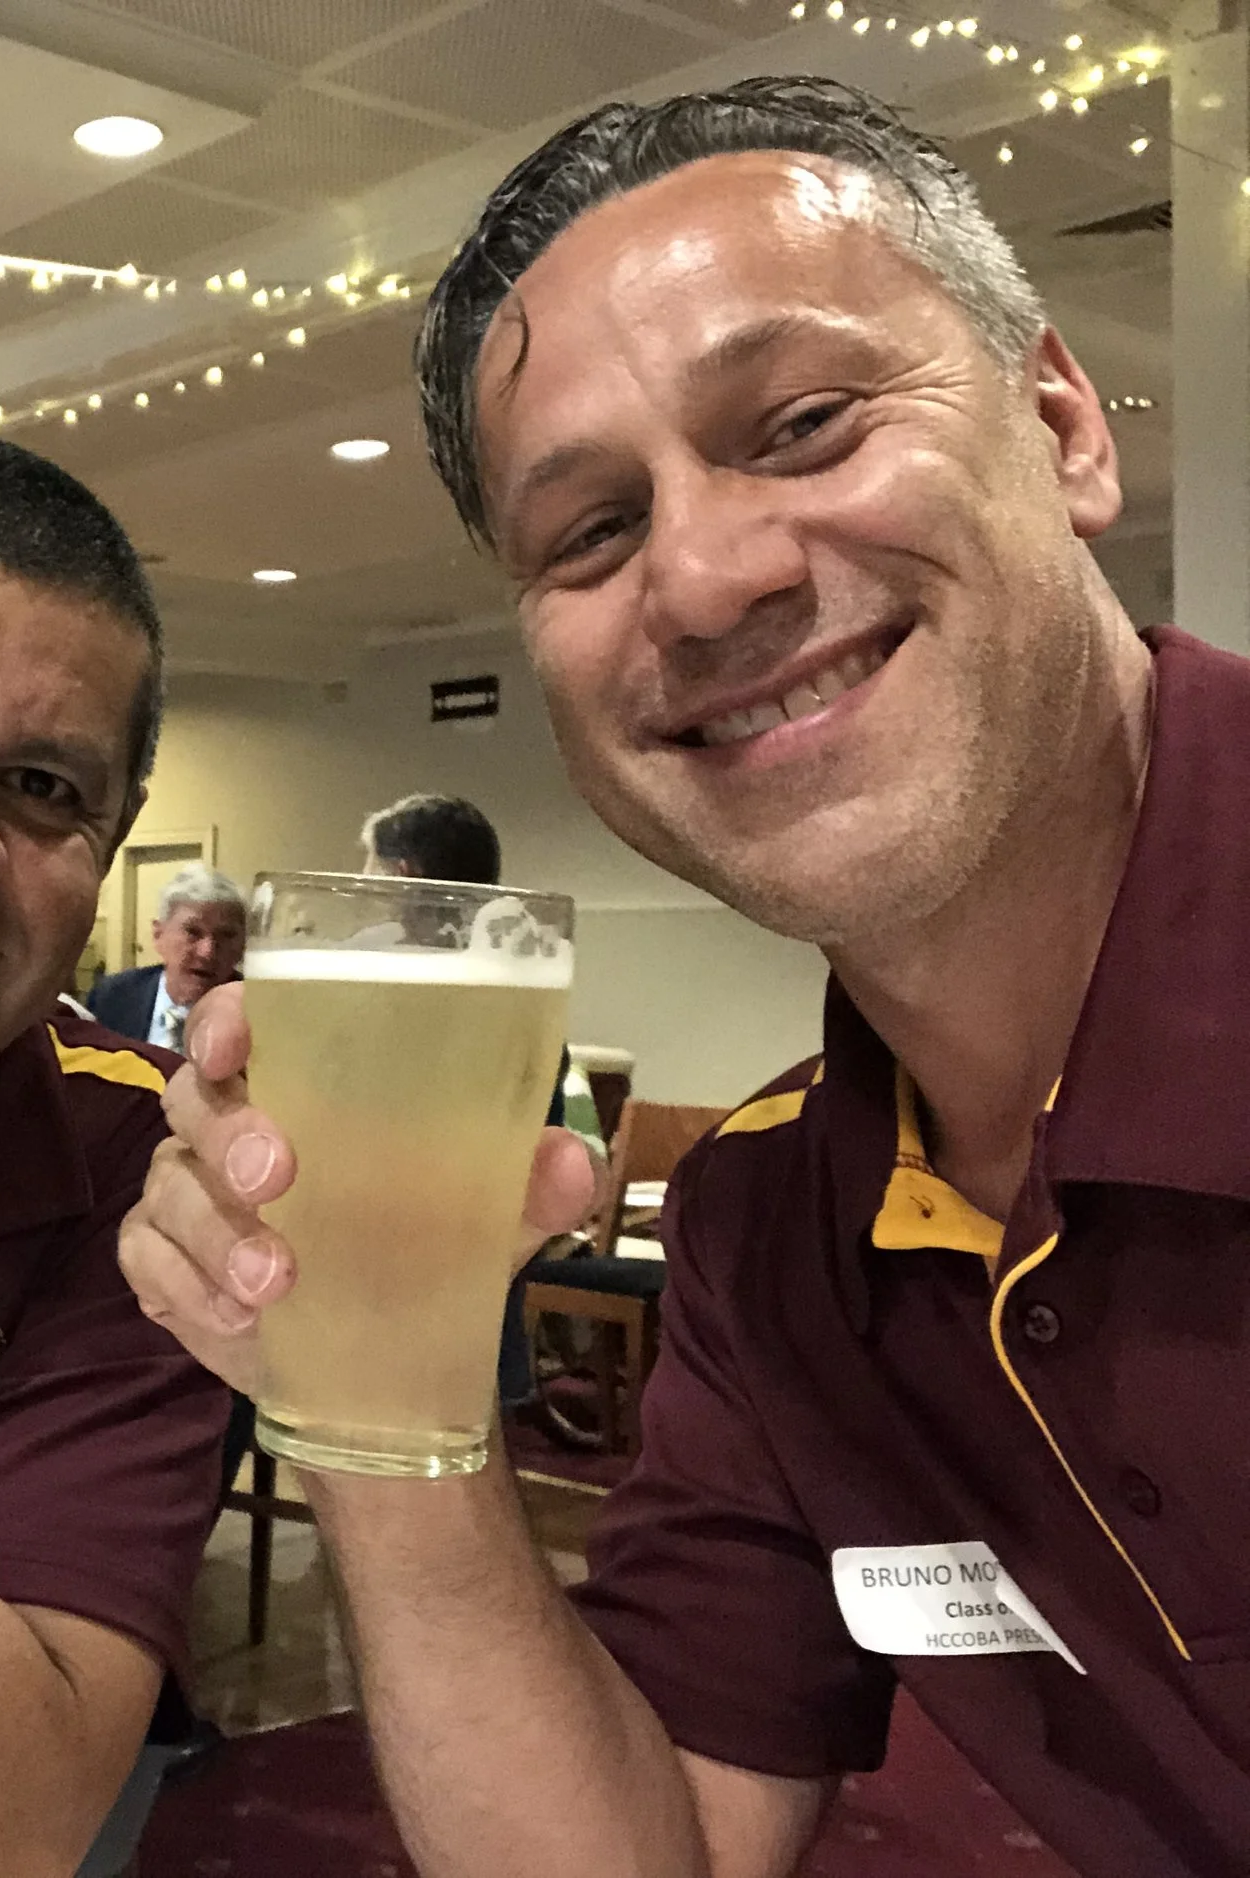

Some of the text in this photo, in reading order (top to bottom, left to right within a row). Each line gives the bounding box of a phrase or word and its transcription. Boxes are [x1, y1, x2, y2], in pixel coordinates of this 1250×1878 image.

[860, 1564, 953, 1588] BRUNO
[945, 1600, 993, 1618] Class
[925, 1629, 1001, 1649] HCCOBA
